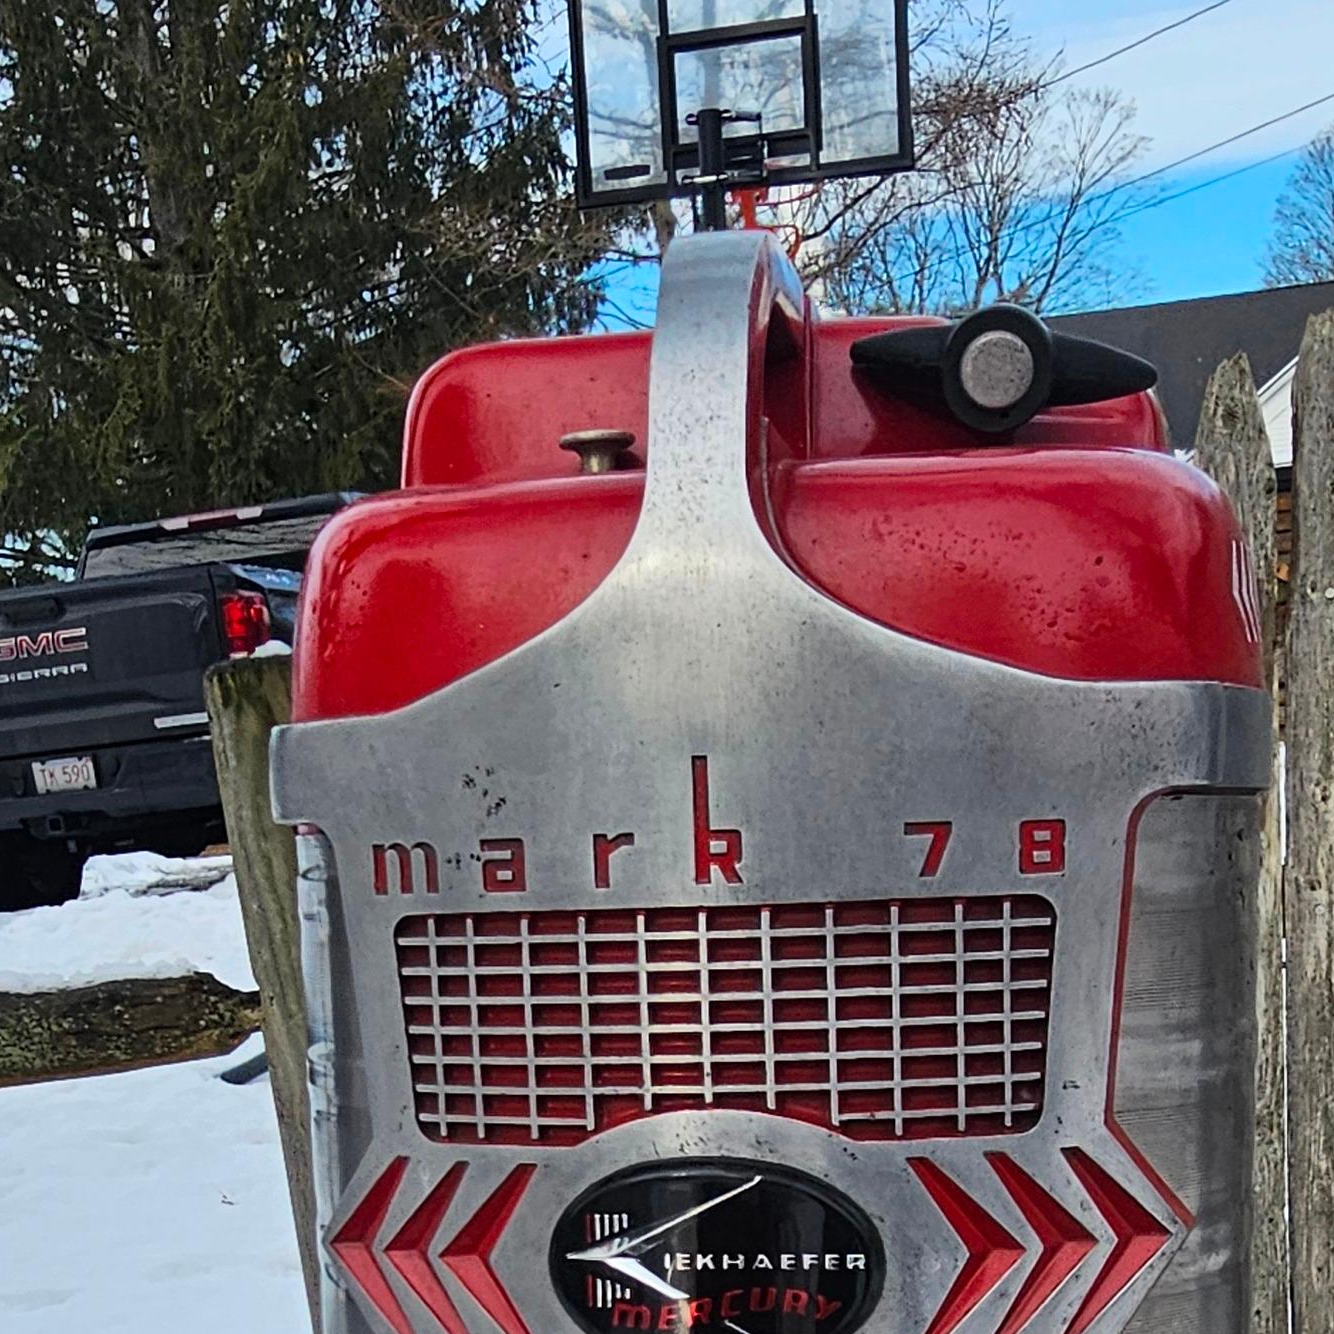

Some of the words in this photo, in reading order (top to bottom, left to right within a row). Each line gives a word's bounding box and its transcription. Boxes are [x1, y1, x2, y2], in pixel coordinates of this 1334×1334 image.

[62, 763, 90, 784] 590
[372, 754, 745, 895] mark
[903, 817, 1067, 877] 78
[611, 1286, 843, 1331] MERCURY
